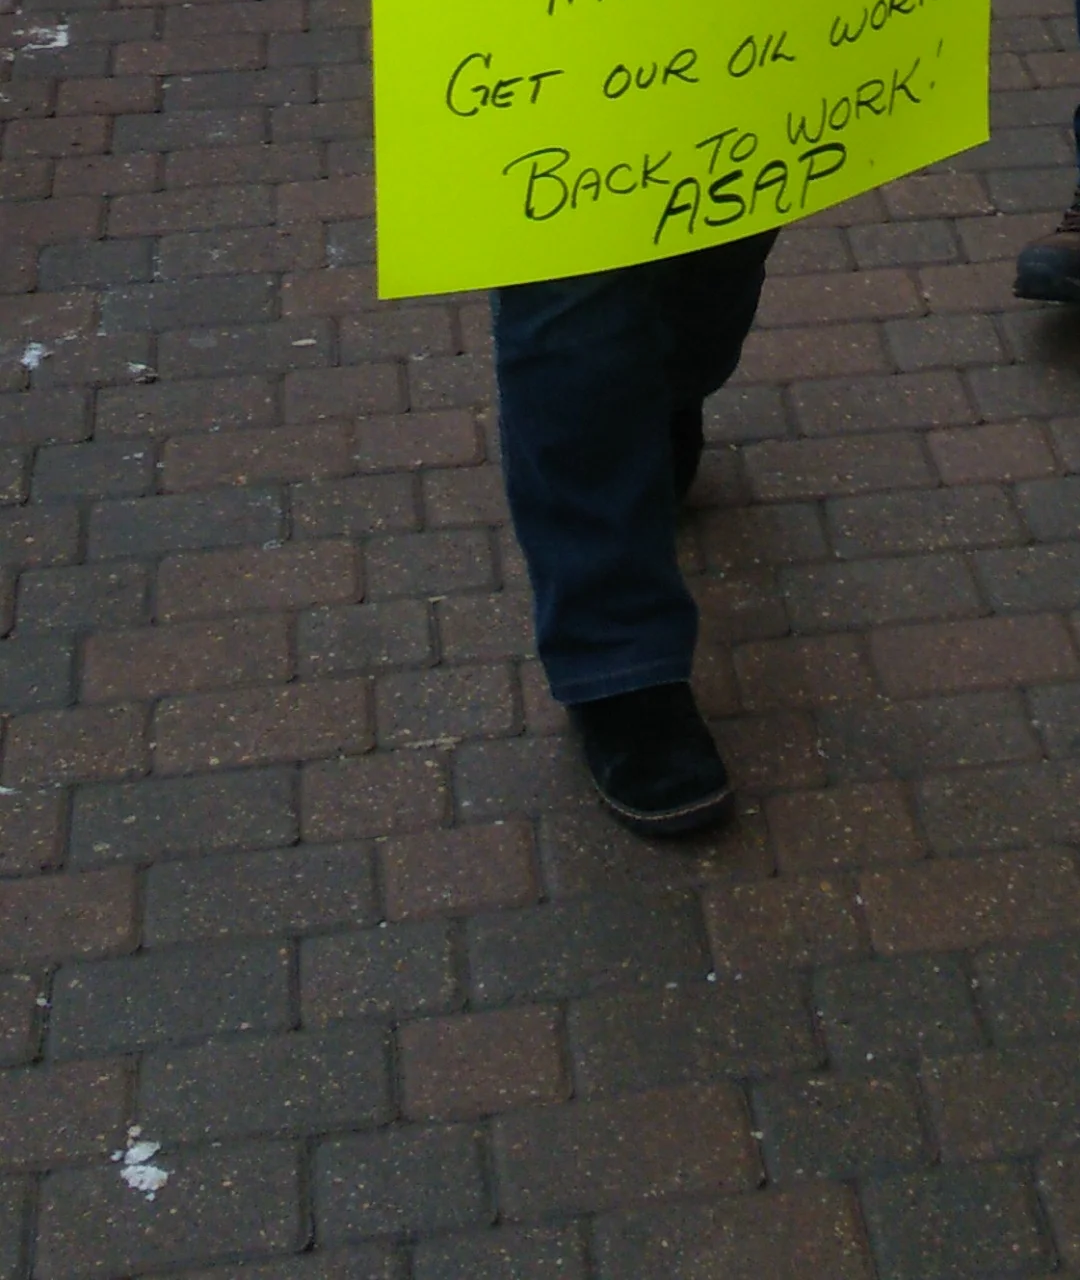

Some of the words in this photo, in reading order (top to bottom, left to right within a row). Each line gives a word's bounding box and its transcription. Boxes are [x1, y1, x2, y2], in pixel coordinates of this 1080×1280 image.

[445, 52, 565, 117] GET
[603, 48, 700, 99] OUR
[727, 31, 796, 78] OIL
[502, 146, 672, 221] BACK
[695, 127, 759, 176] TO
[653, 142, 848, 246] ASAP
